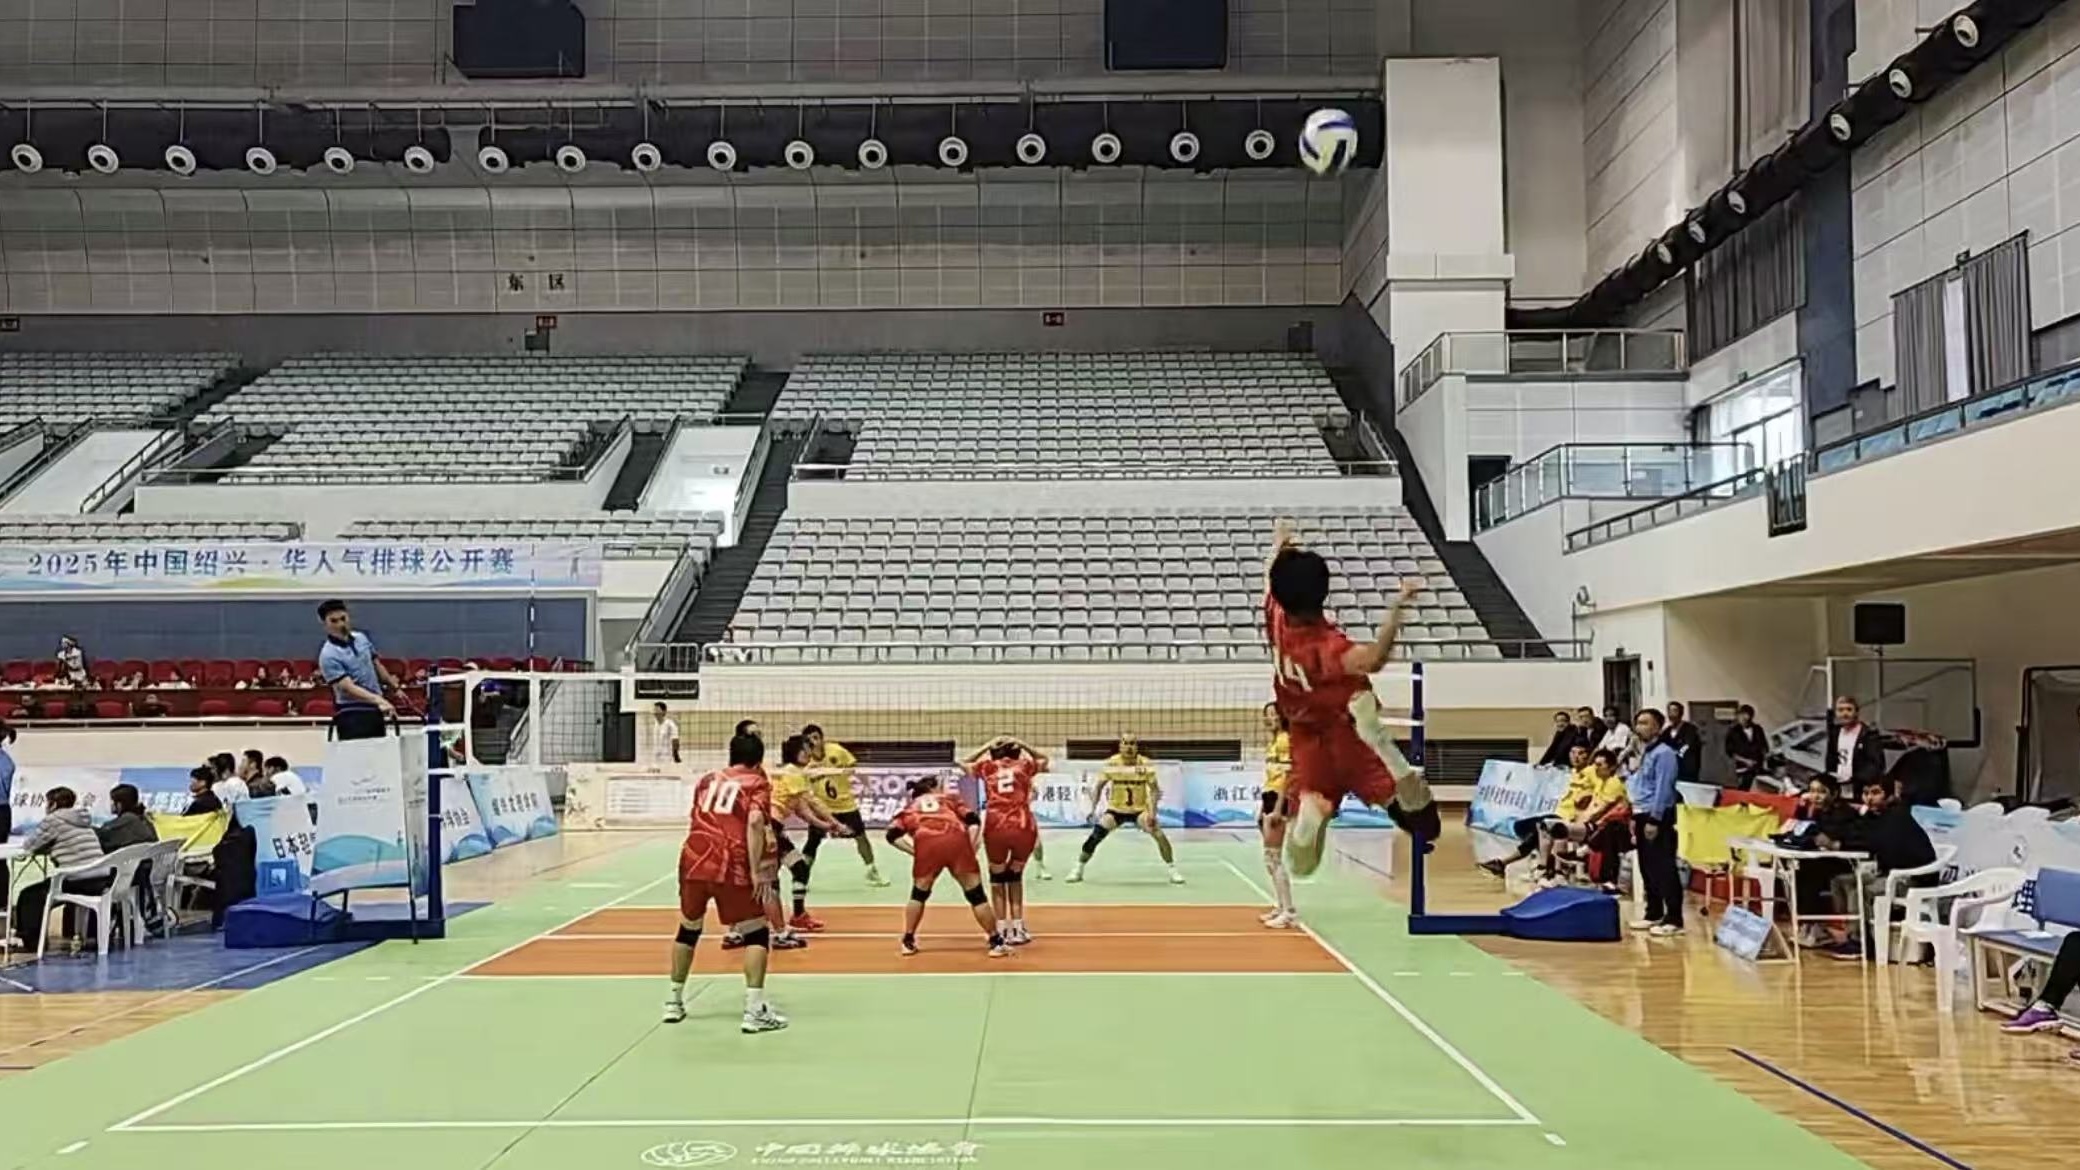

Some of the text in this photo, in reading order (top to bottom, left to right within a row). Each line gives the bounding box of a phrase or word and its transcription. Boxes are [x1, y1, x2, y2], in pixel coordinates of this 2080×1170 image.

[1273, 646, 1312, 692] 14
[825, 779, 838, 800] 6
[997, 768, 1014, 794] 2
[701, 779, 742, 814] 10
[1125, 786, 1134, 807] 1
